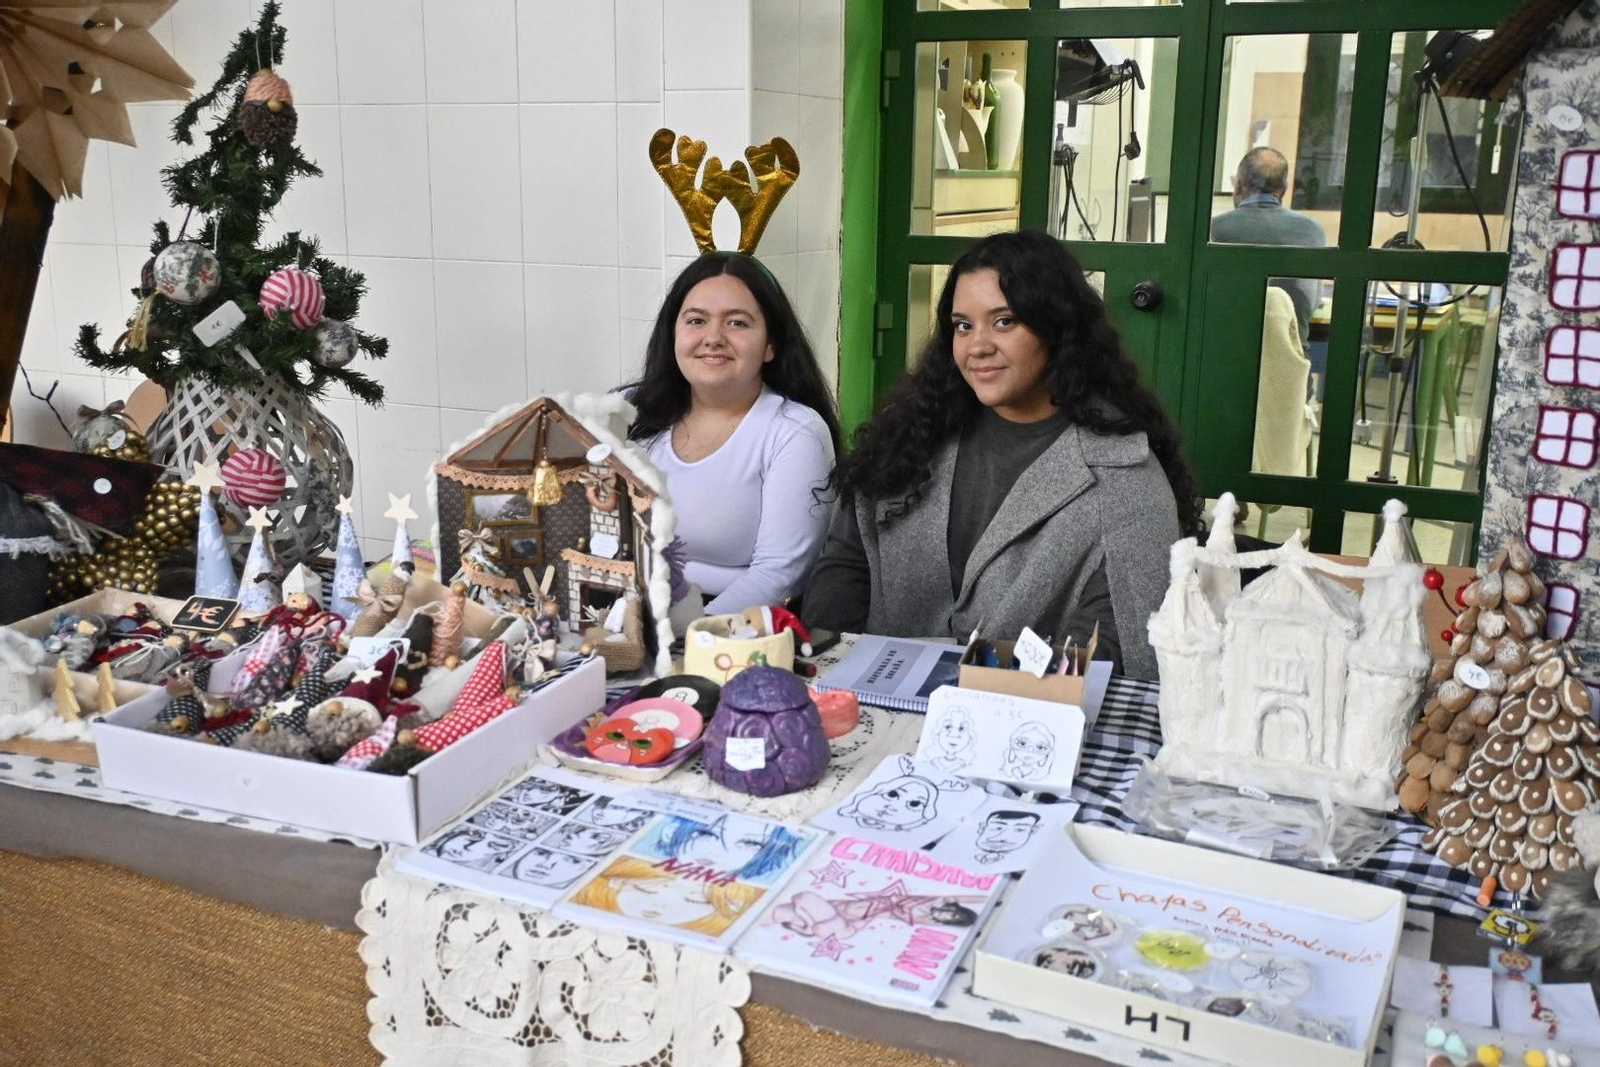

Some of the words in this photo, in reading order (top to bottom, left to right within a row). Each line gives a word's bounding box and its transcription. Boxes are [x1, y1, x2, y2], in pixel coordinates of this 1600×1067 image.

[187, 600, 223, 625] 4€
[866, 657, 893, 685] HISTORIA
[651, 857, 739, 887] NANA
